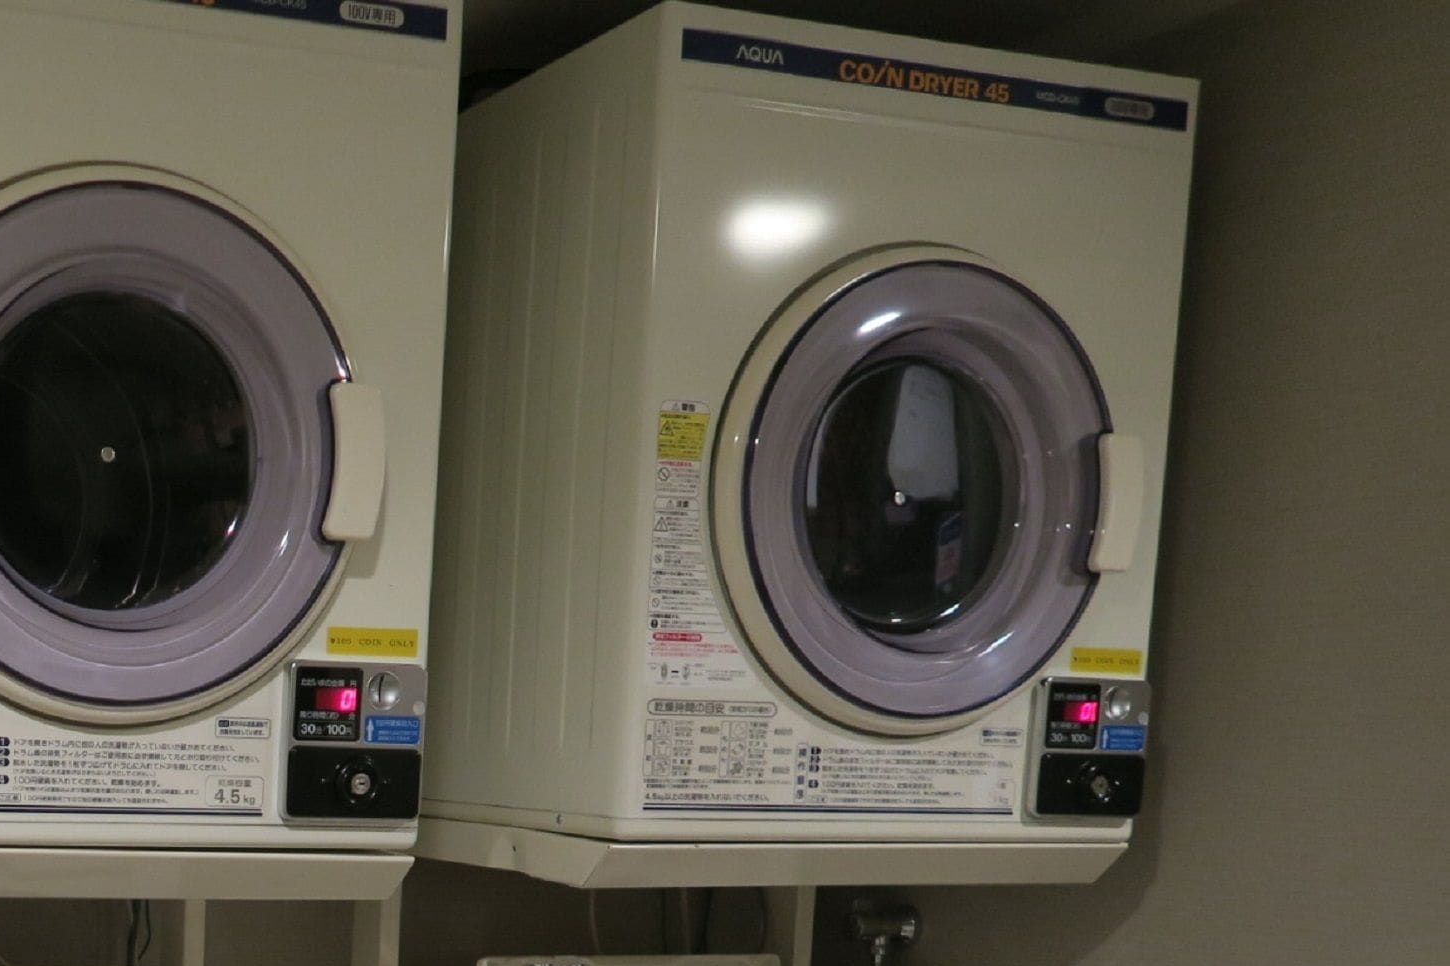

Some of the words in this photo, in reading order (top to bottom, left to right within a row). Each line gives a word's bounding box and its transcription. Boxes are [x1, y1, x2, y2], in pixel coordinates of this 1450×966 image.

[736, 43, 785, 65] AQUA
[908, 70, 979, 99] DRYER
[983, 82, 1011, 104] 45
[358, 638, 382, 646] COIN
[389, 639, 414, 647] ONLY
[340, 690, 352, 709] 0
[214, 788, 240, 804] 4.5
